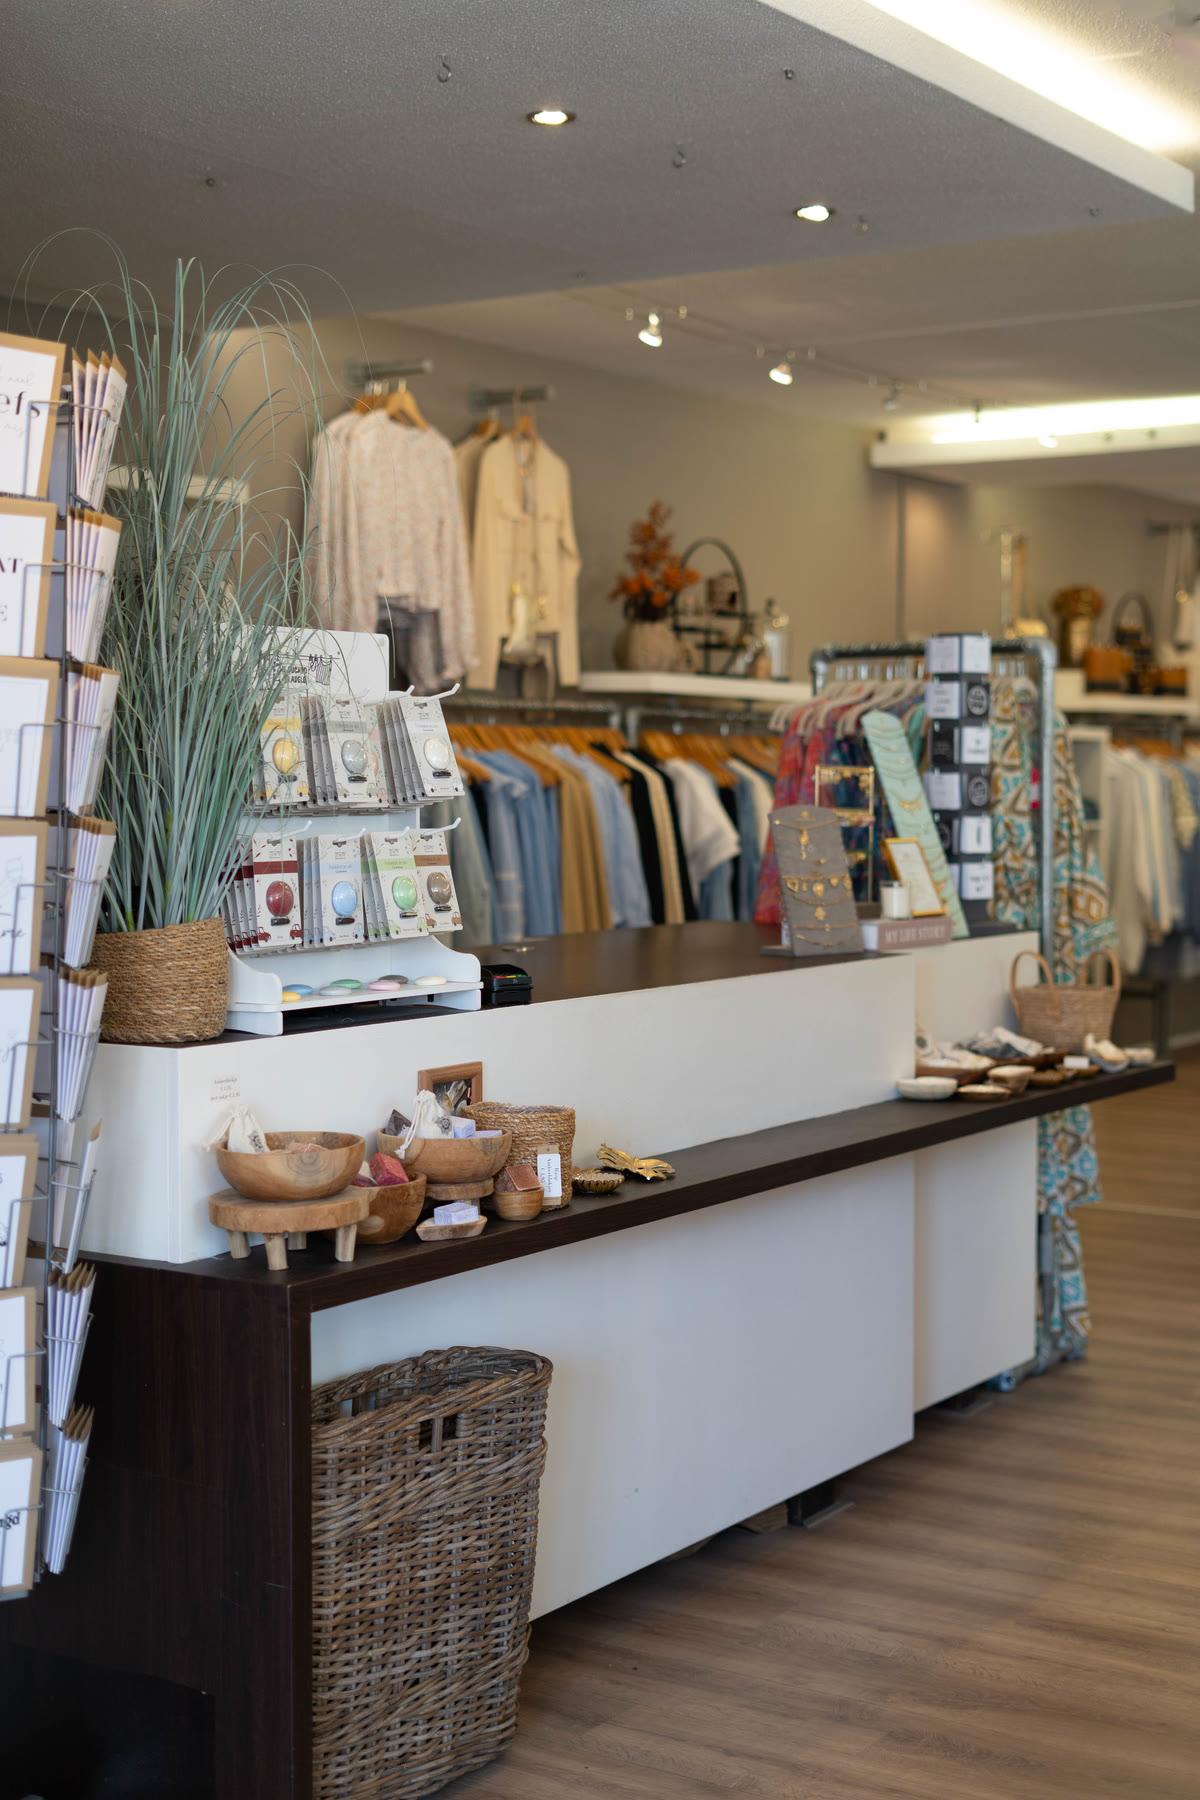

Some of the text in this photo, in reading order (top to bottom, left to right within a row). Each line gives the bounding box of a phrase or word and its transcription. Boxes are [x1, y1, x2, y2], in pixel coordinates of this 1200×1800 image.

[885, 925, 945, 944] MY LIFE STORY
